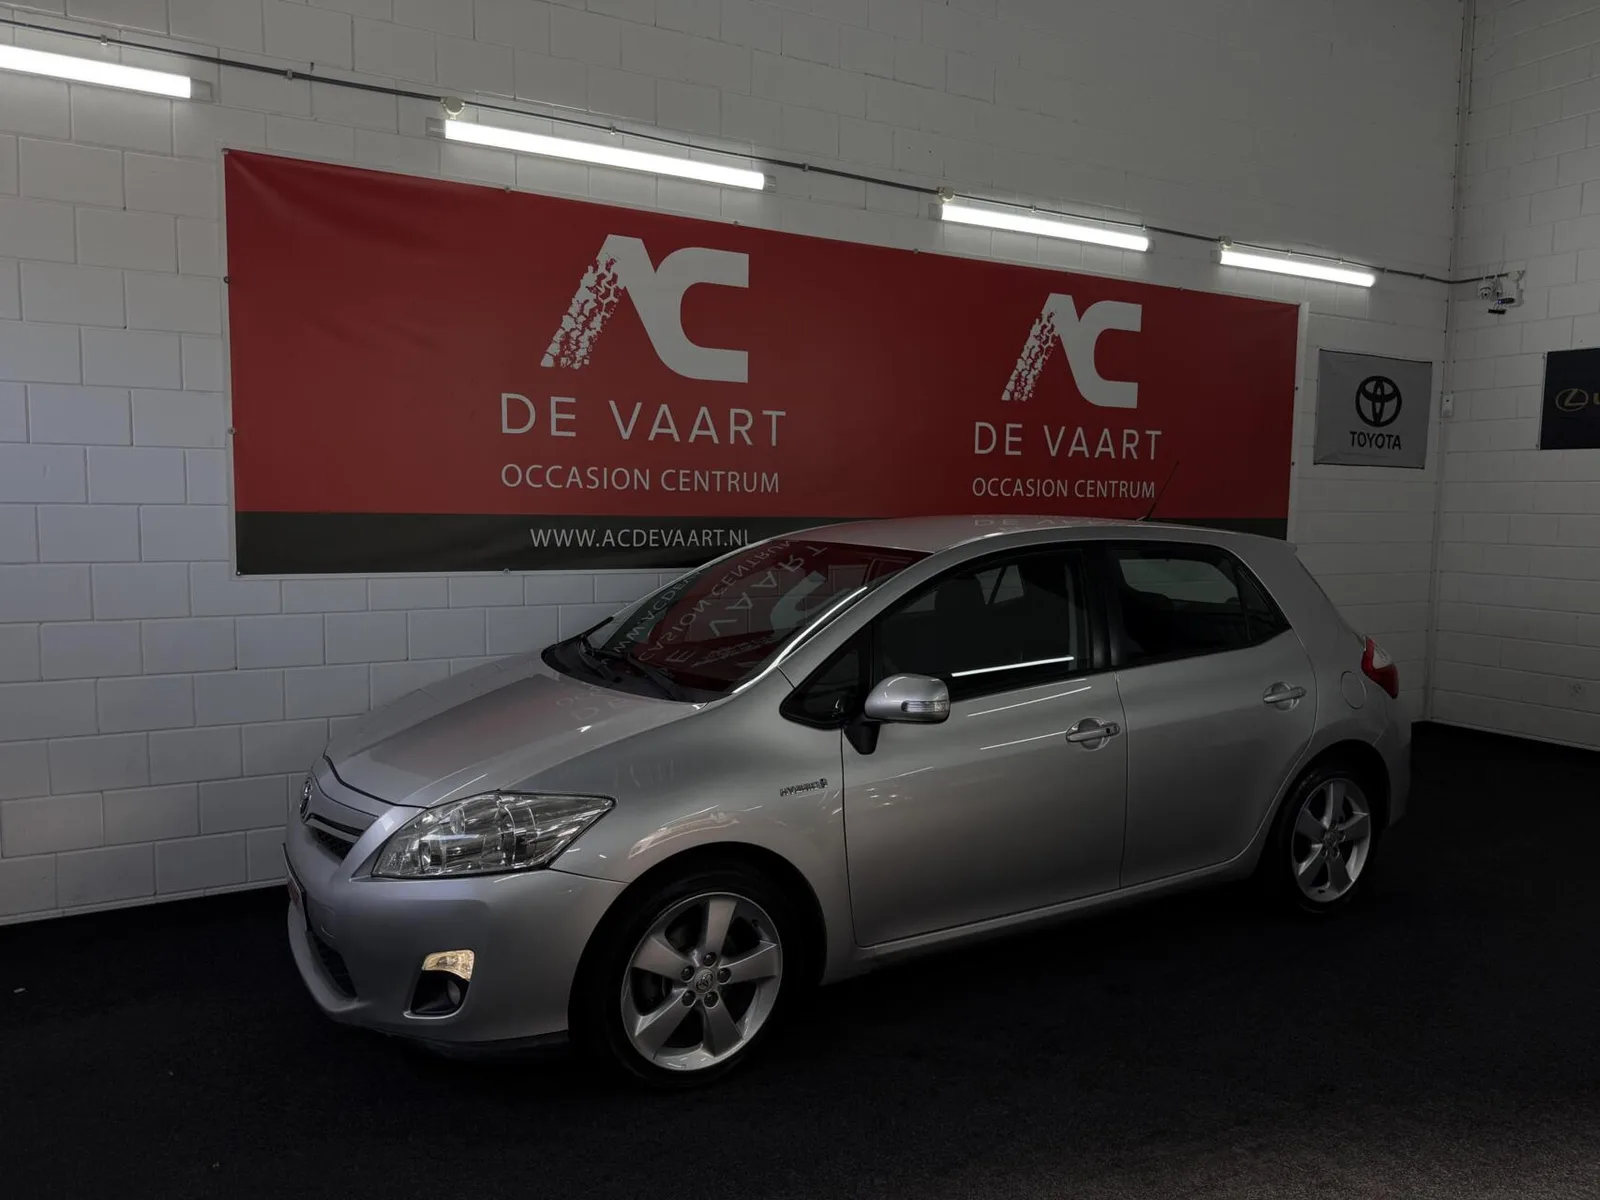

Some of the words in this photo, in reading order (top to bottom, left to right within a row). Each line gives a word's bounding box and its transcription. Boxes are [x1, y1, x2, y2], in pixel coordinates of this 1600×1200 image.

[540, 233, 749, 383] AC
[1001, 292, 1142, 409] AC
[501, 393, 577, 437] DE
[608, 400, 786, 447] VAART
[974, 421, 1023, 456] DE
[1043, 425, 1162, 461] VAART
[1349, 430, 1402, 450] TOYOTA
[501, 463, 651, 491] OCCASION
[660, 469, 780, 493] CENTRUM
[972, 477, 1068, 498] OCCASION
[1074, 479, 1156, 499] CENTRUM
[529, 528, 751, 548] WWW.ACDEVAART.NL
